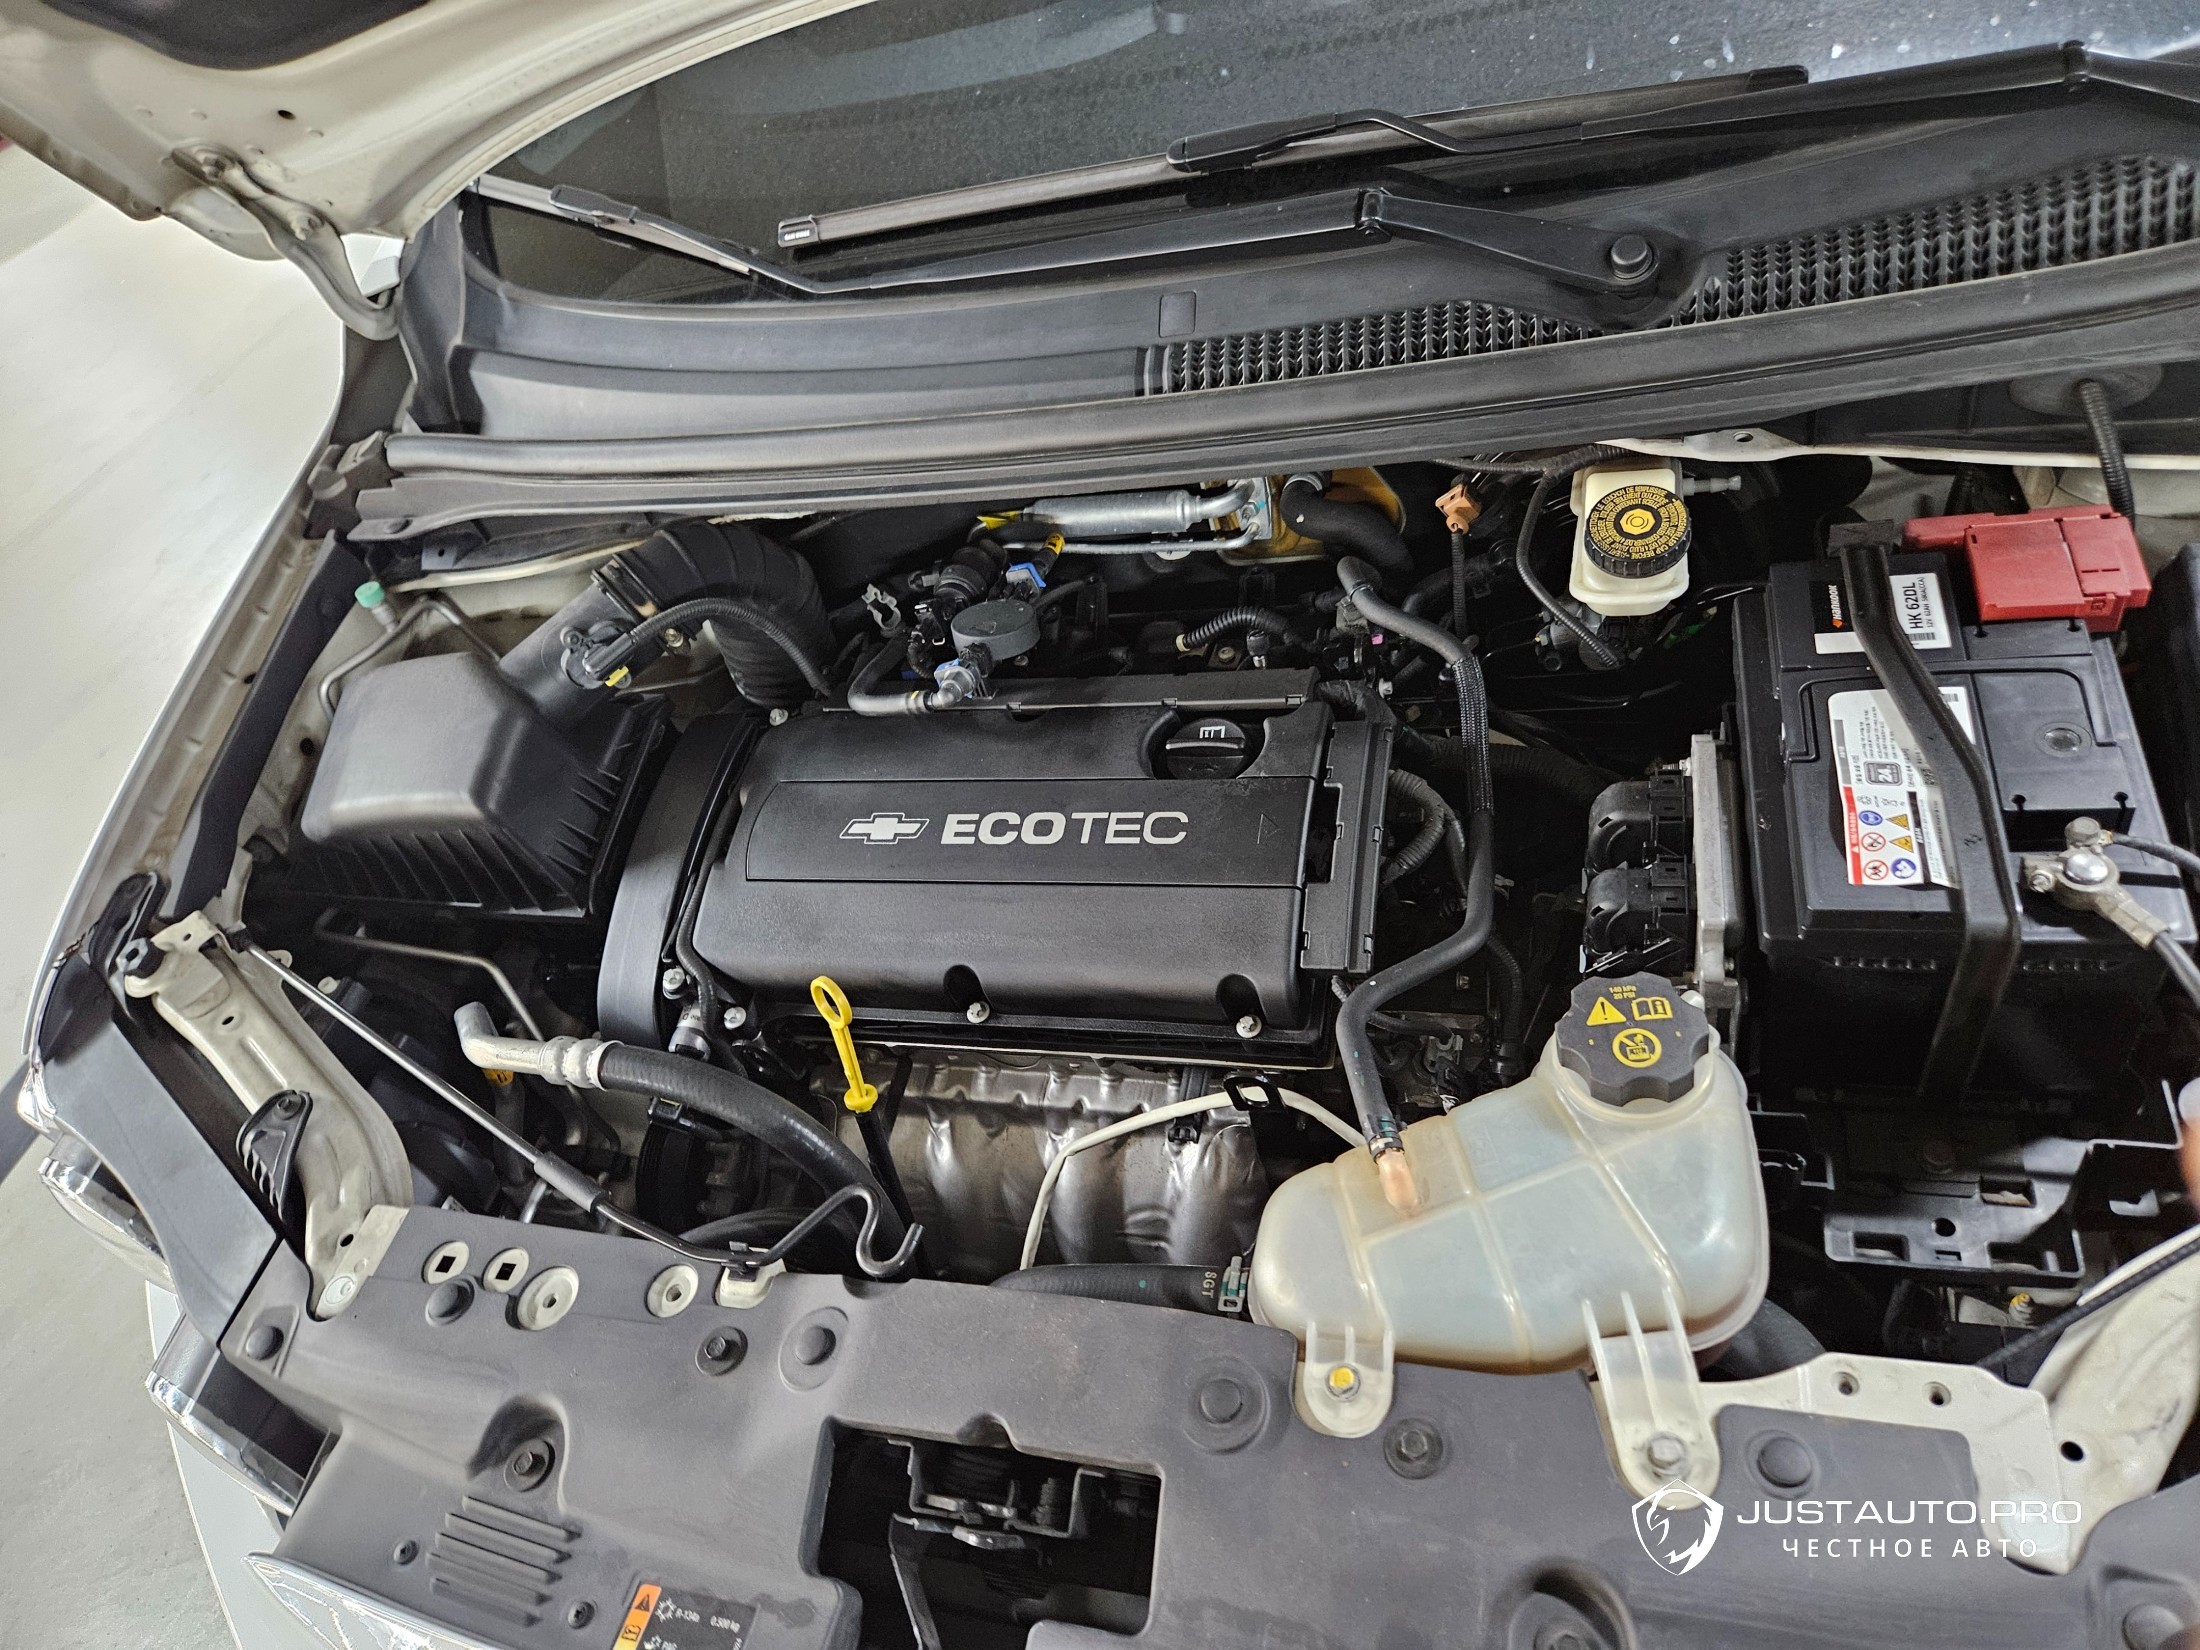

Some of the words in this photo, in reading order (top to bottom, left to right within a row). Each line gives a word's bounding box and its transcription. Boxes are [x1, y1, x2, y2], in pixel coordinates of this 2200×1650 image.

[1655, 545, 1670, 555] CAP
[1902, 582, 1920, 610] 62DL
[1908, 614, 1924, 629] HK
[1925, 618, 1934, 628] 12V
[940, 812, 1188, 844] ECOTEC
[1201, 1271, 1217, 1298] SGT
